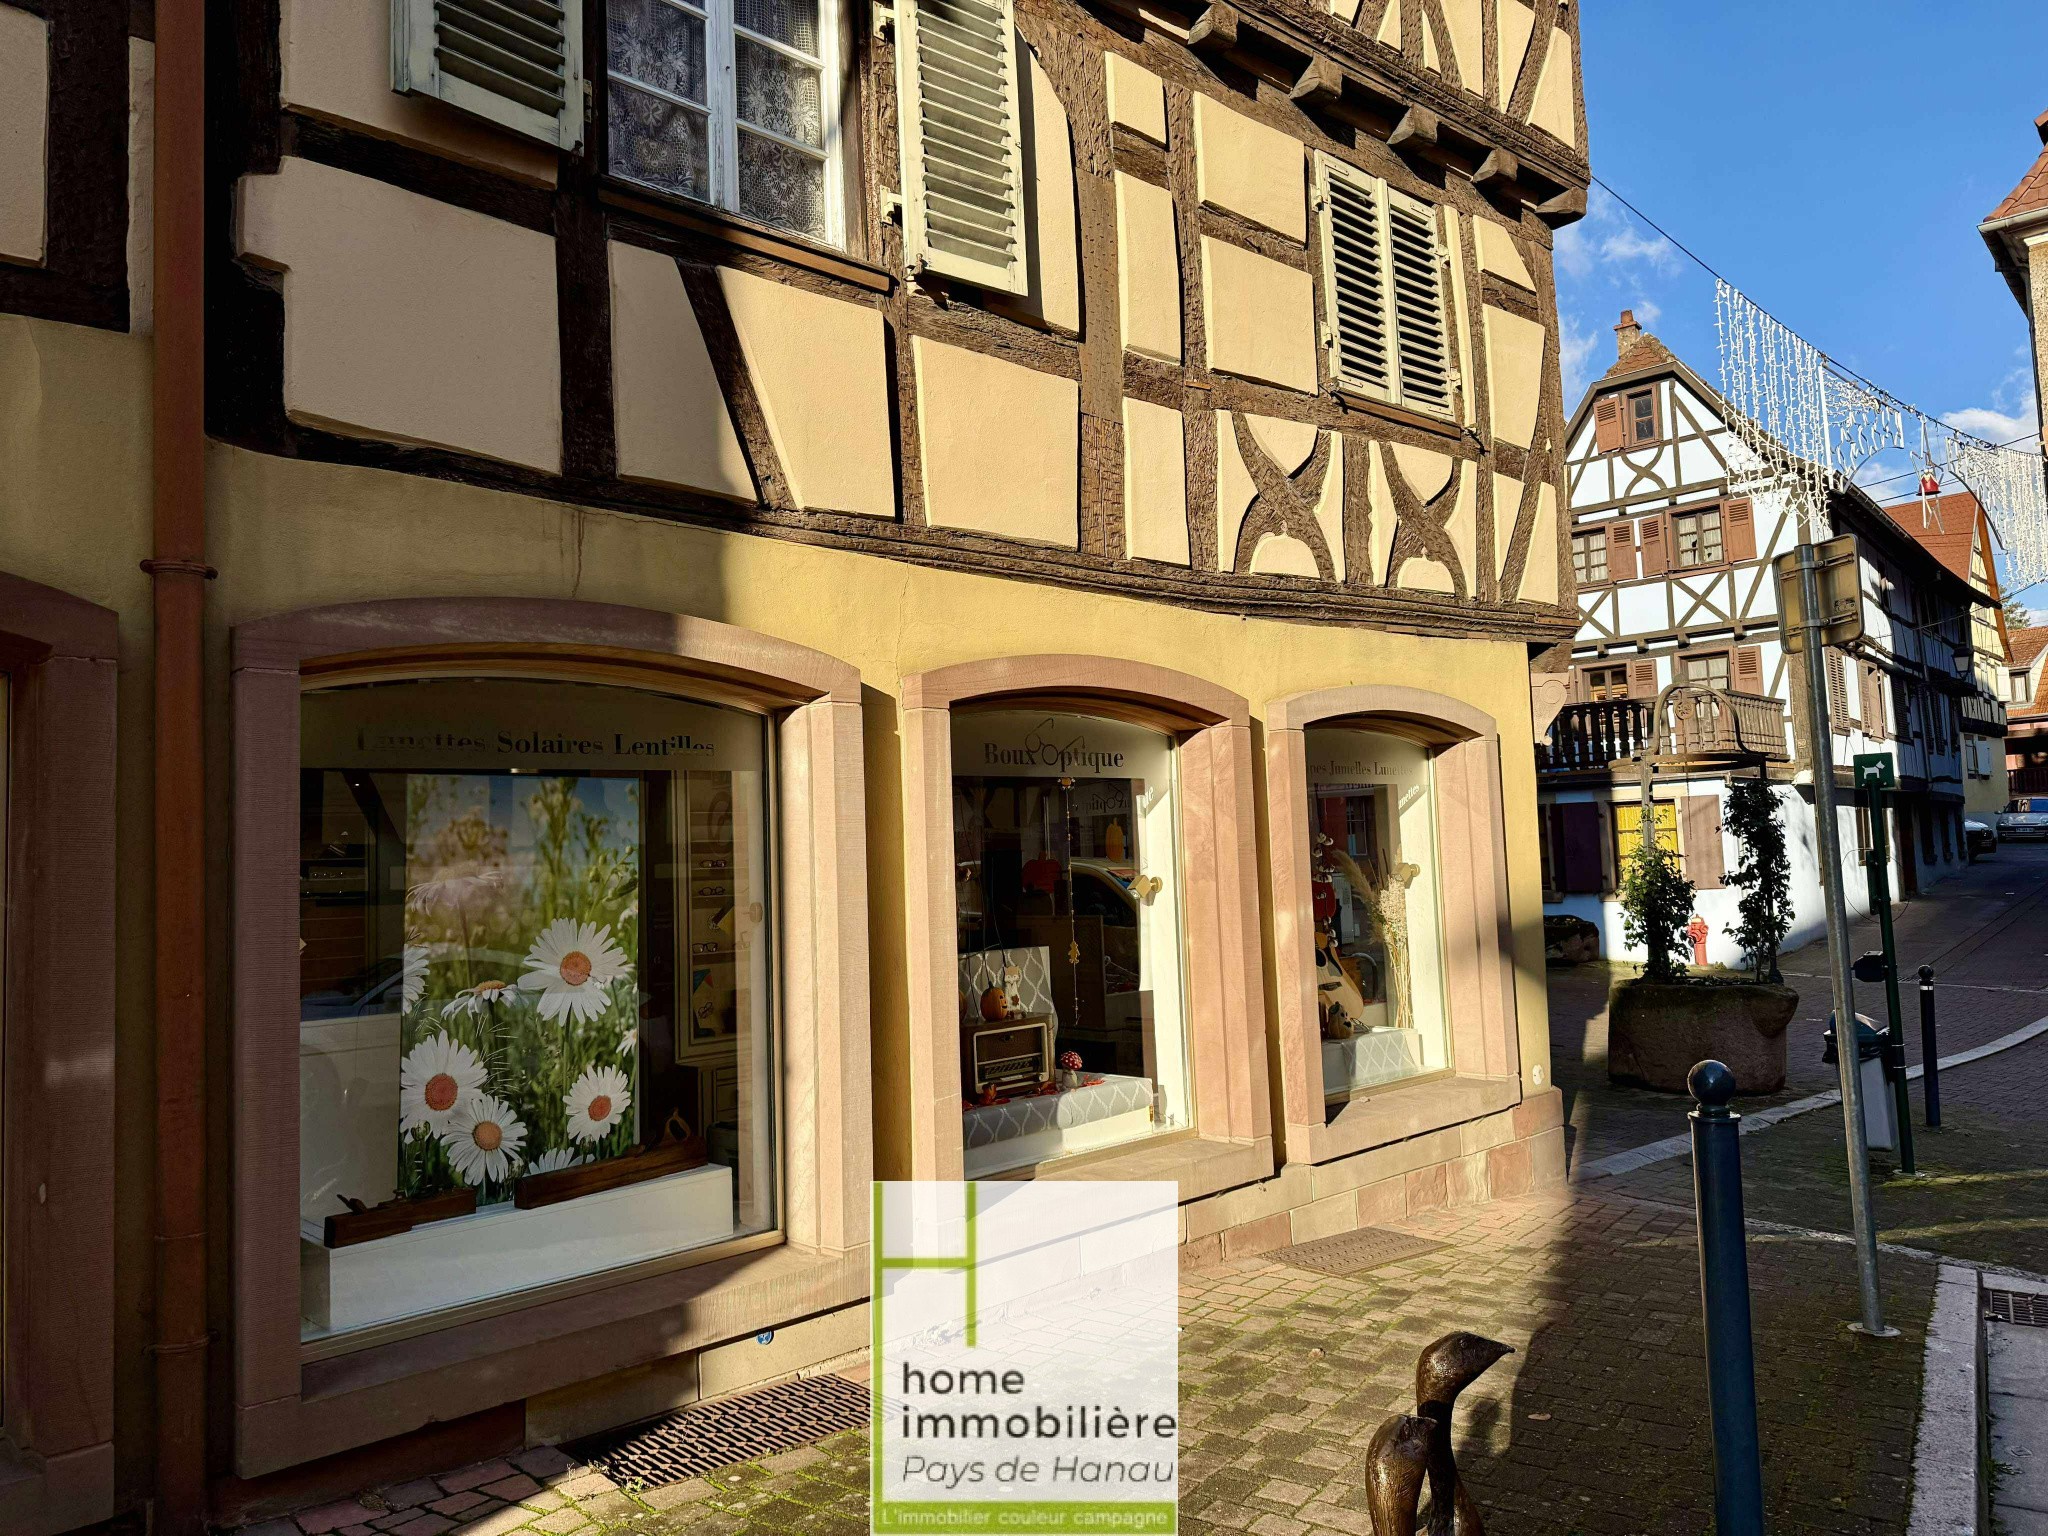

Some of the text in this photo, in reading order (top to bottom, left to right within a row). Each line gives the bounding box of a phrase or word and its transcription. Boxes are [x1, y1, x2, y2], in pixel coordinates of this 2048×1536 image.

[357, 728, 487, 753] Lnttes
[497, 729, 604, 756] Solaires
[983, 742, 1124, 774] Boux Optique
